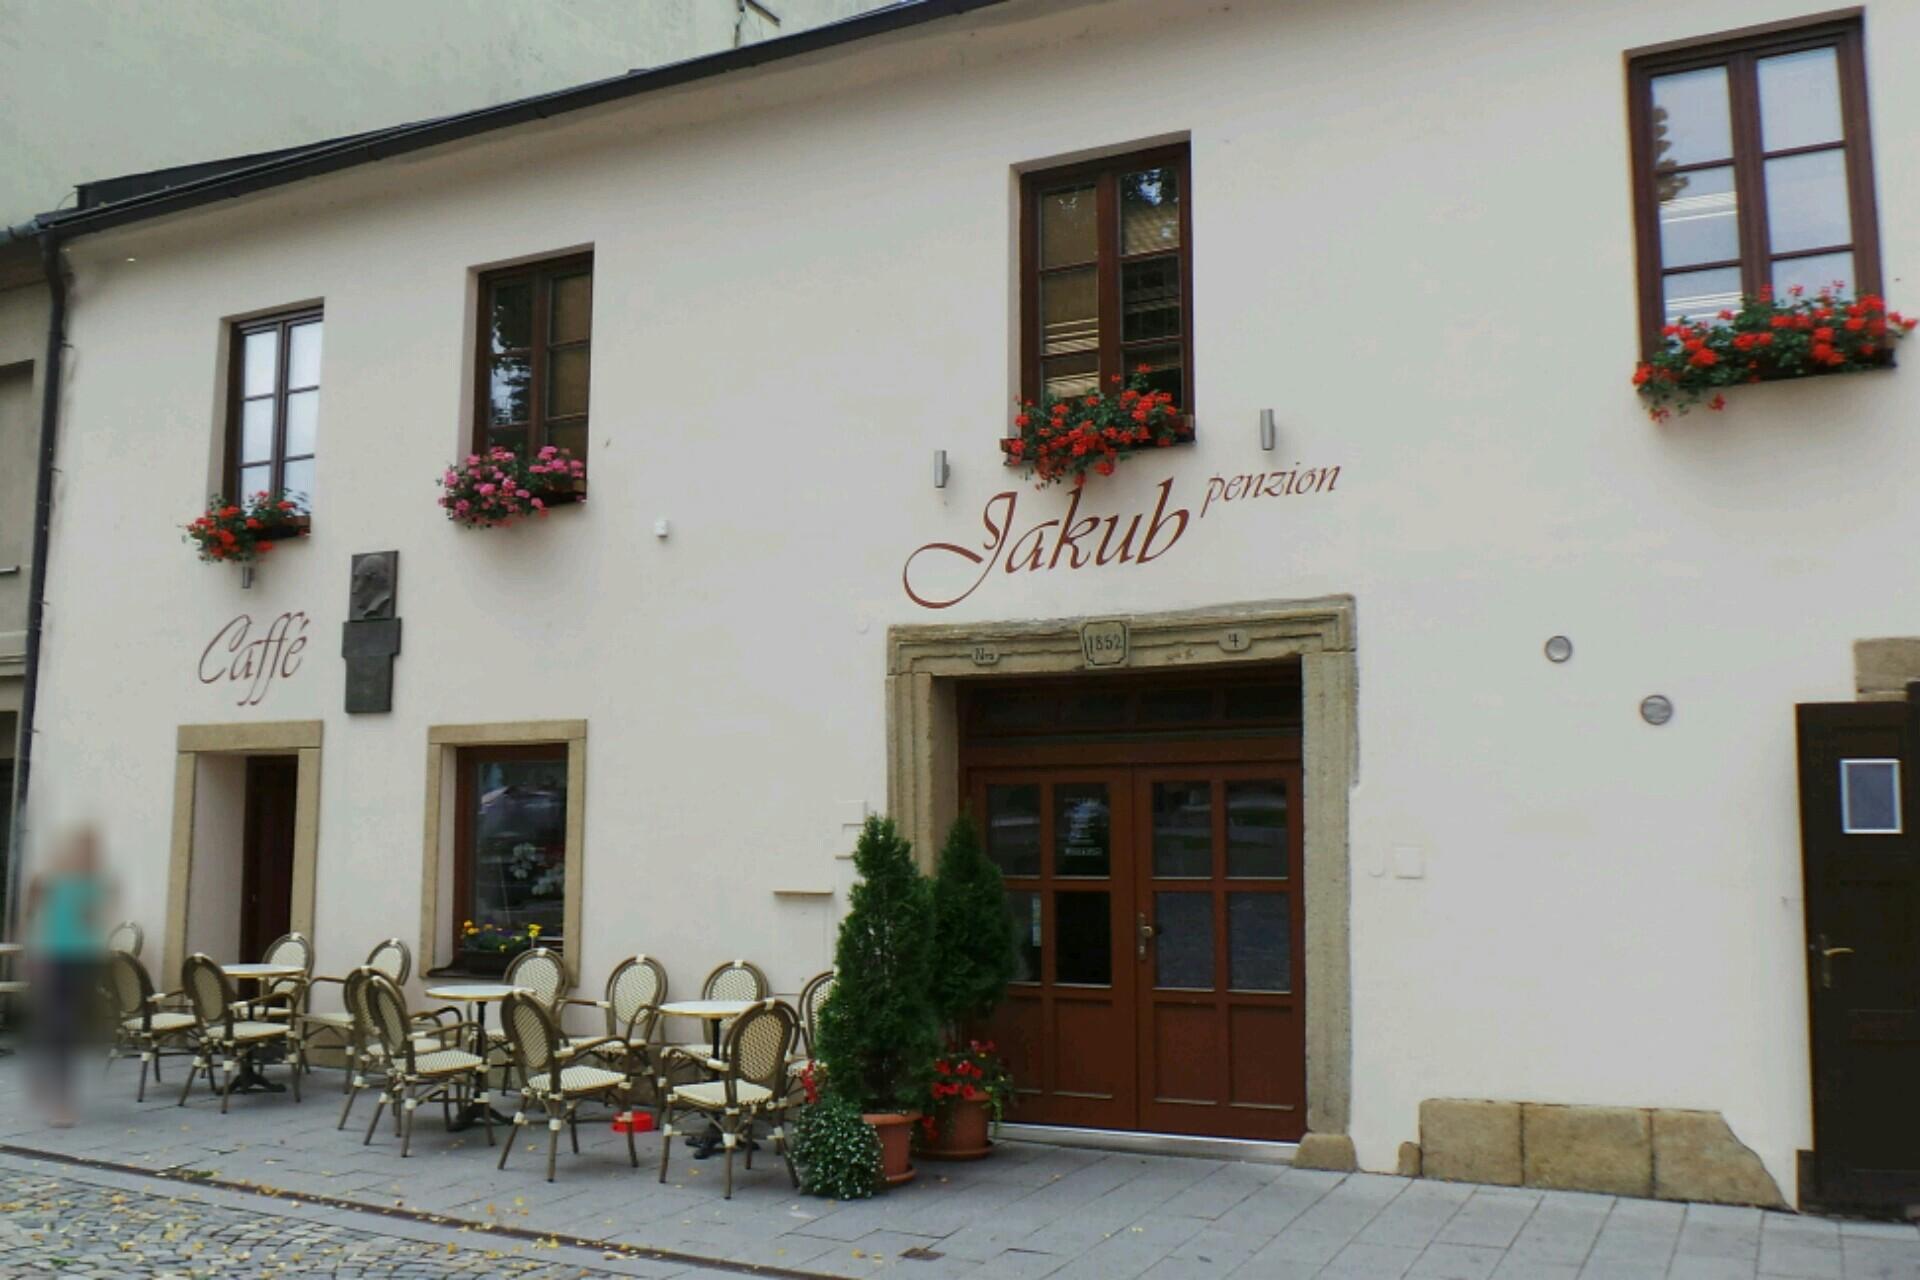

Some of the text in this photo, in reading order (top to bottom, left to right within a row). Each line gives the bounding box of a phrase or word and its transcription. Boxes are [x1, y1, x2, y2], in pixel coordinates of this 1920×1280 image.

[902, 462, 1342, 609] Jakub penzion
[1228, 633, 1240, 648] 4
